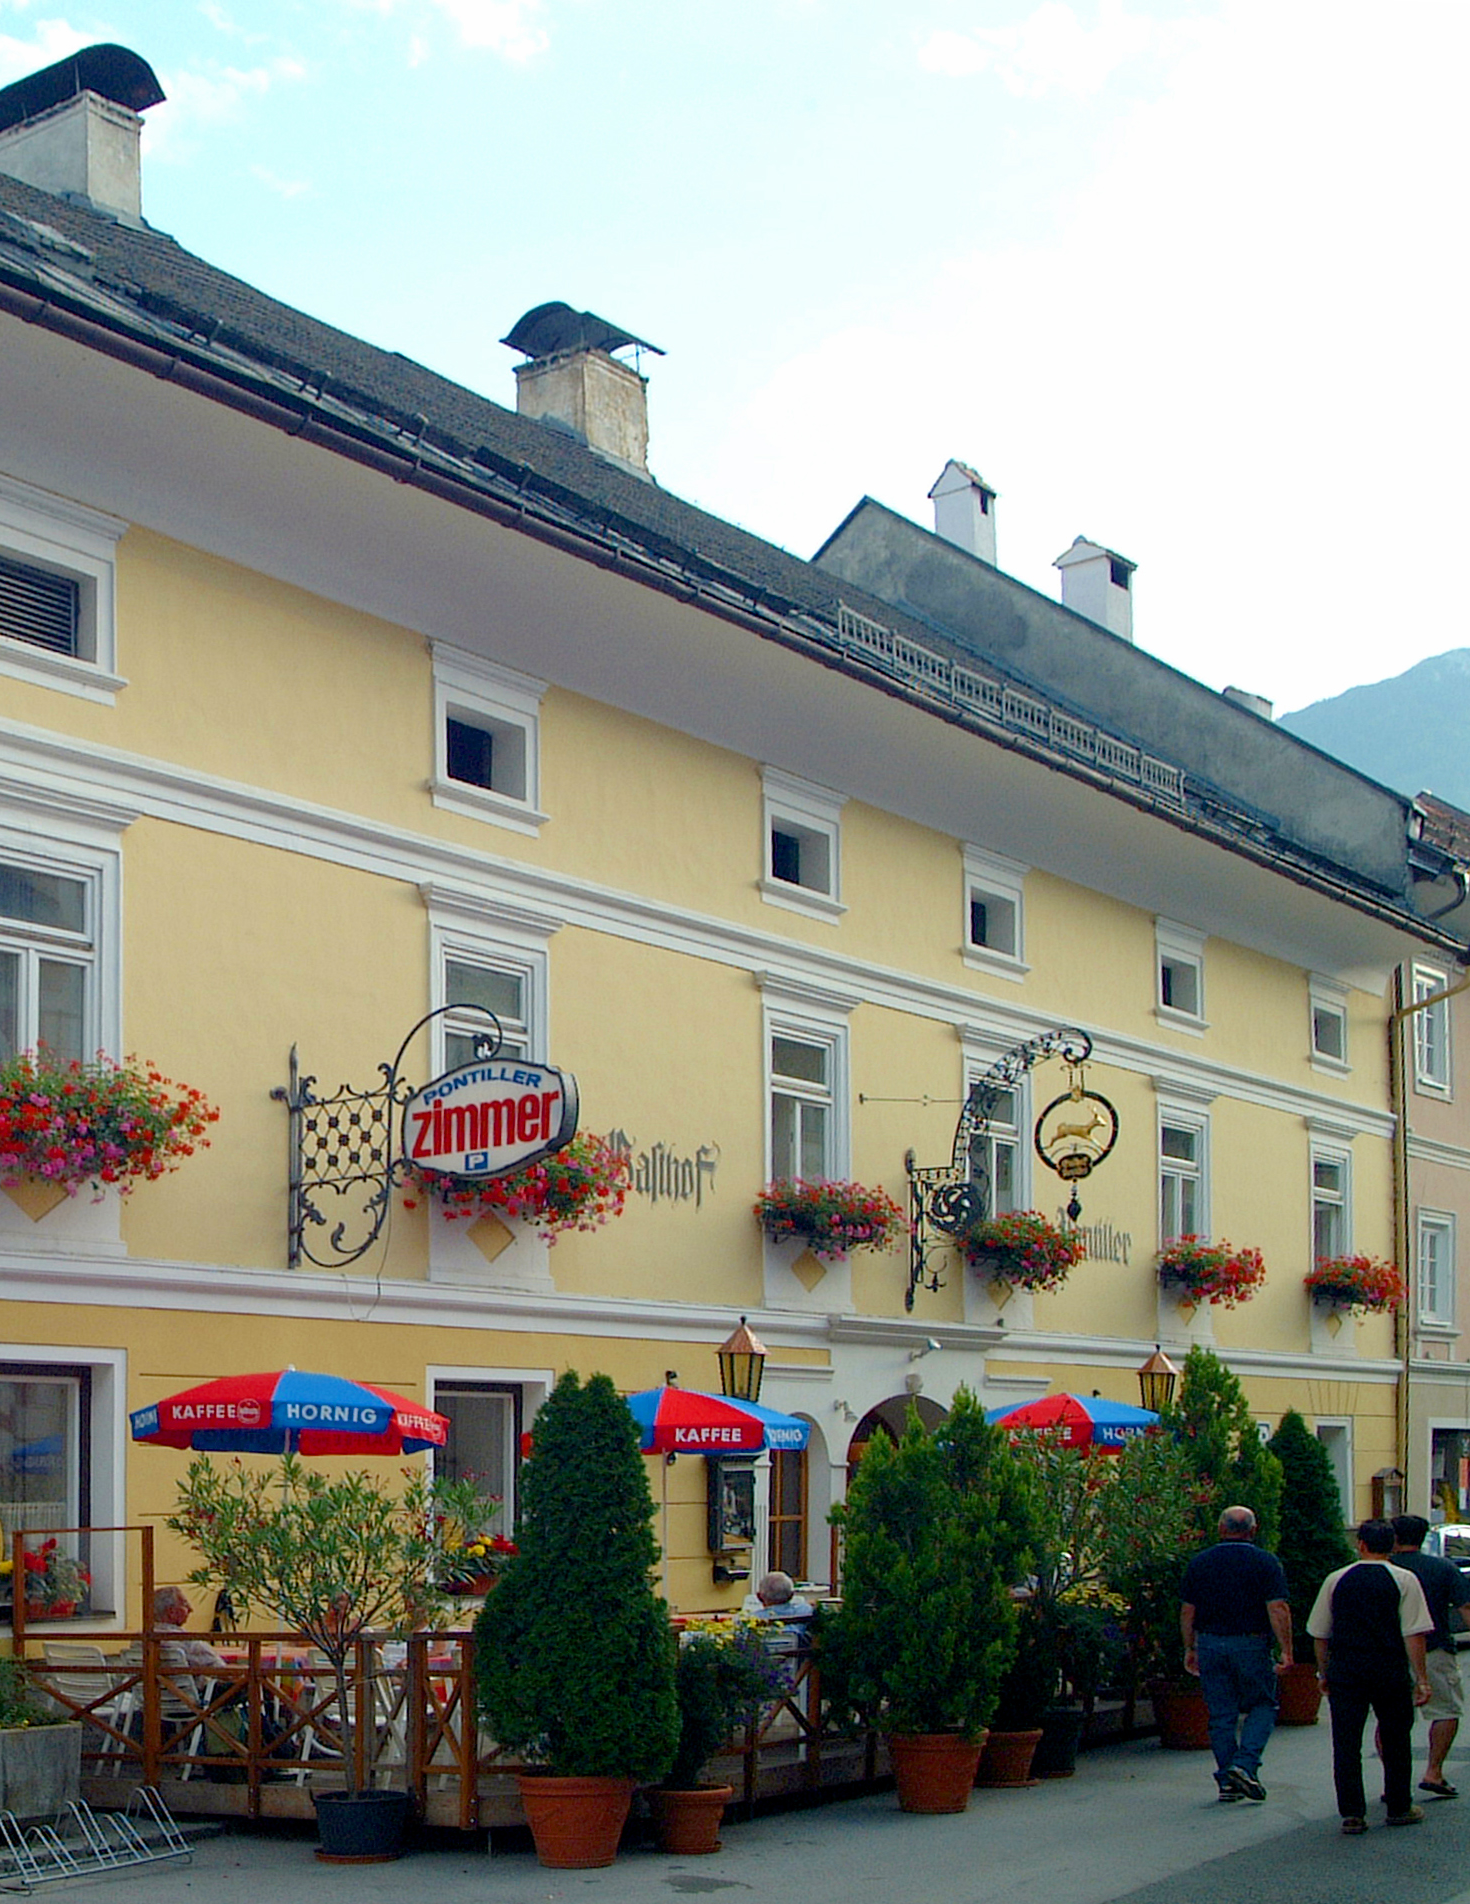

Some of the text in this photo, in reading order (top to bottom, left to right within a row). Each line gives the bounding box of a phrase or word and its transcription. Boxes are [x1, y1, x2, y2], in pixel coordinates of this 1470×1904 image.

[423, 1067, 542, 1106] PONTILLER
[411, 1090, 560, 1159] zimmer
[171, 1403, 238, 1420] KAFFEE
[286, 1403, 378, 1425] HORNIG
[674, 1427, 742, 1443] KAFFEE
[1009, 1426, 1072, 1442] KAFFE
